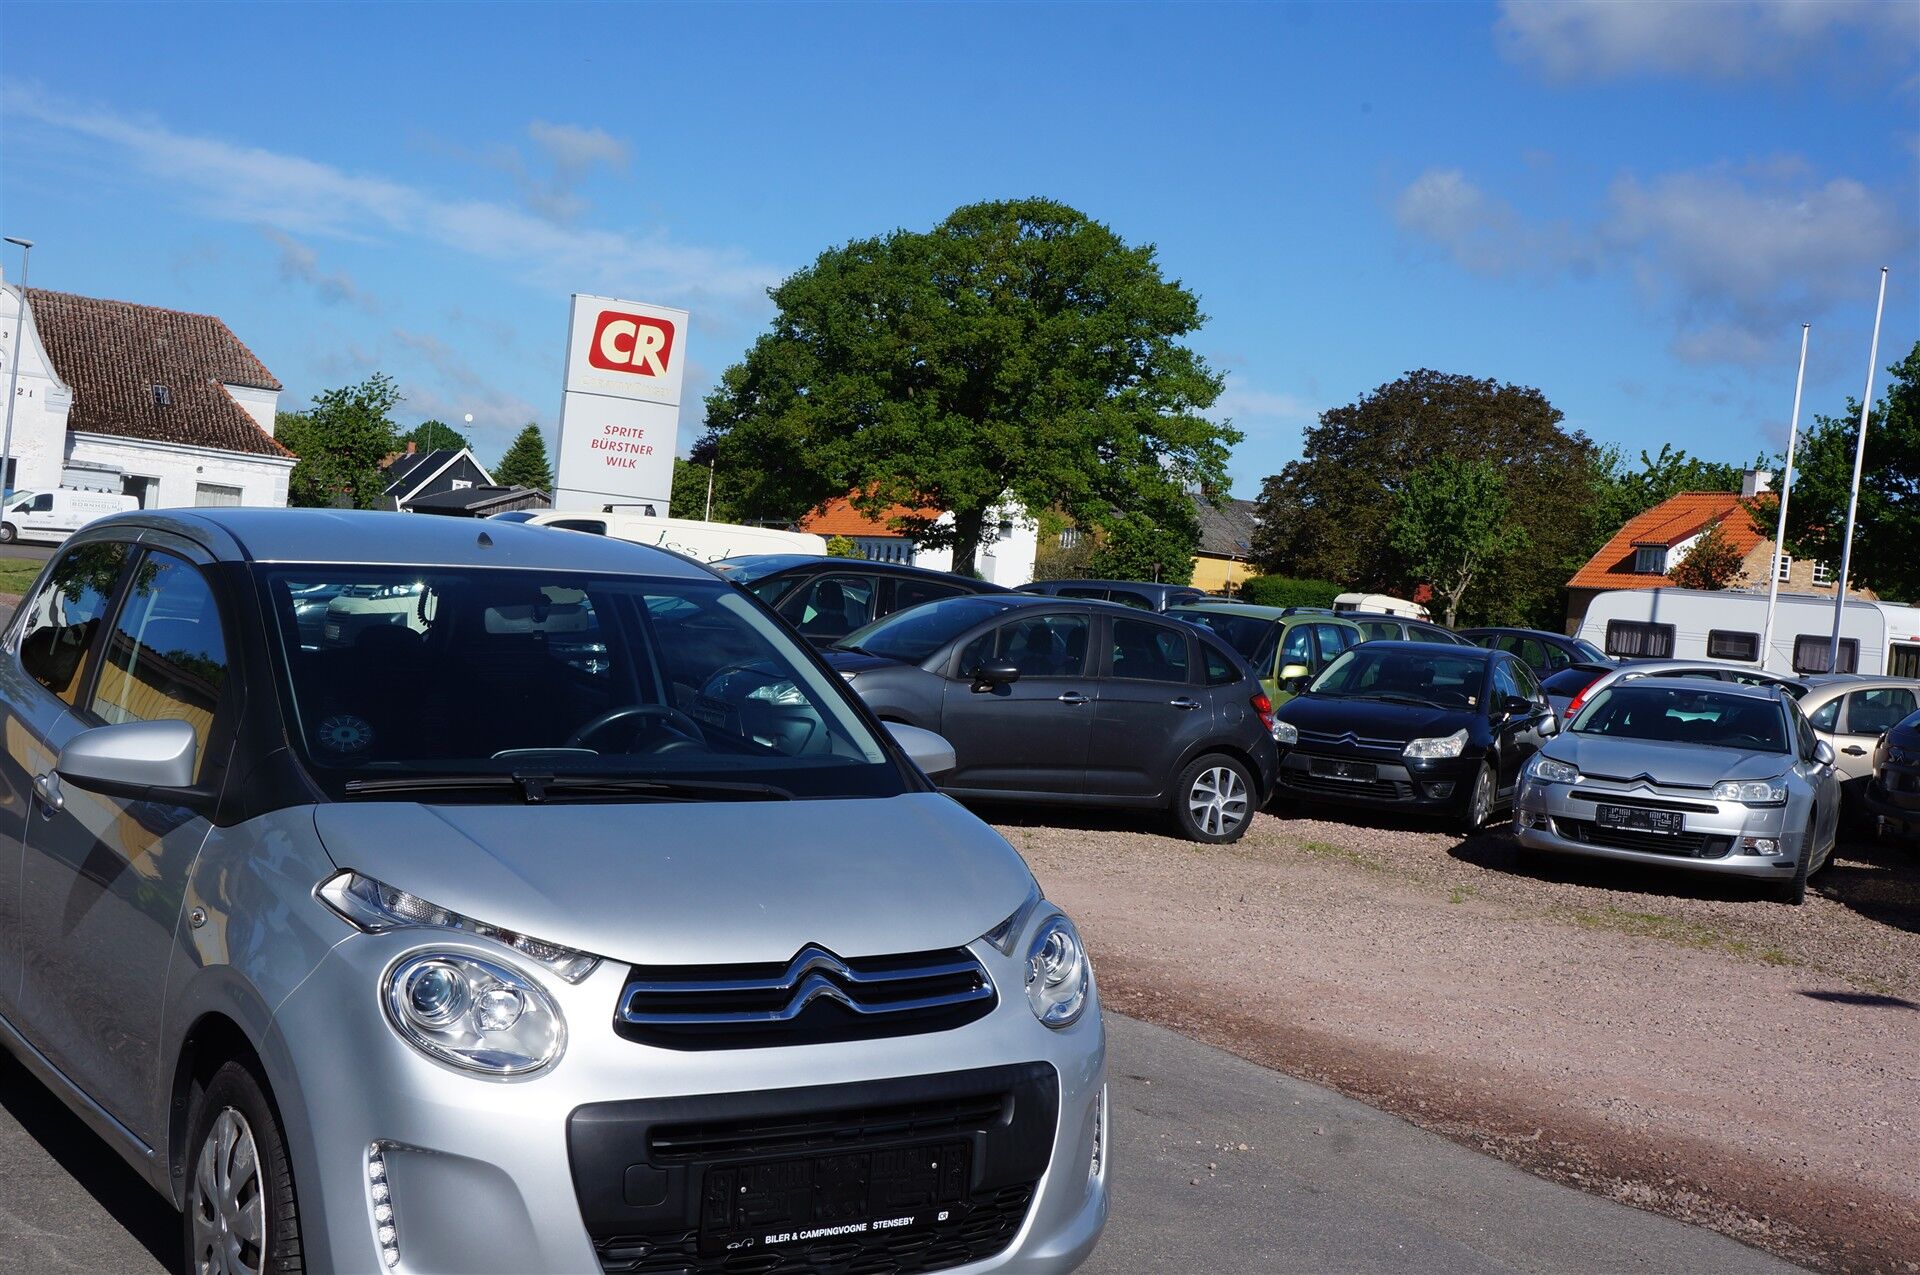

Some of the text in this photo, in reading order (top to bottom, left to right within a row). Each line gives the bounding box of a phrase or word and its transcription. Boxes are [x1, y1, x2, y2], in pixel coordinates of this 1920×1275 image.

[600, 319, 667, 377] CR
[604, 424, 645, 439] SPRITE
[591, 438, 653, 456] BÜRSTNER
[606, 456, 637, 469] WILK
[765, 1233, 790, 1244] BILER
[791, 1232, 798, 1241] &
[799, 1223, 867, 1240] CAMPINGVOGNE
[872, 1216, 915, 1230] STENSEBY
